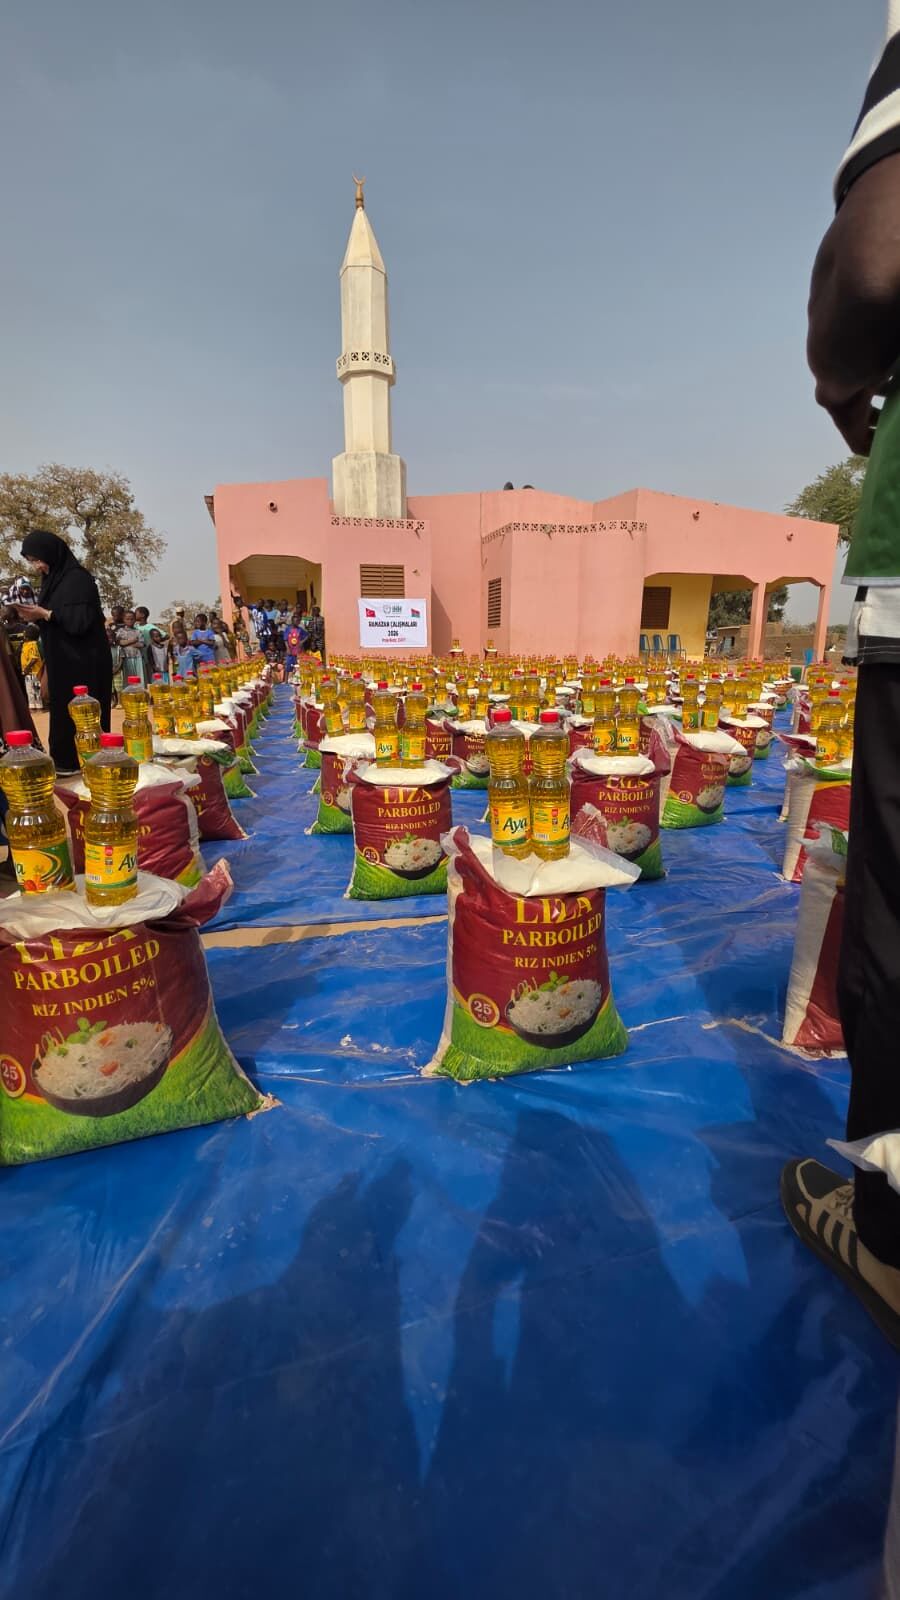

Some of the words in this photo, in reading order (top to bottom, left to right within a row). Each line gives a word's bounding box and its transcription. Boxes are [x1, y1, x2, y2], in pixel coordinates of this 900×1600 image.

[384, 787, 433, 804] LIZA
[377, 801, 441, 818] PARBOILED
[515, 897, 593, 924] LIZA
[502, 912, 602, 948] PARBOILED
[13, 939, 161, 991] PARBOILED
[514, 956, 540, 969] RIZ
[542, 950, 585, 969] INDIEN
[586, 943, 598, 958] 5%
[32, 1003, 61, 1017] RIZ
[63, 986, 129, 1015] INDIEN
[132, 977, 156, 995] 5%
[473, 1000, 492, 1015] 25
[2, 1063, 19, 1081] 25
